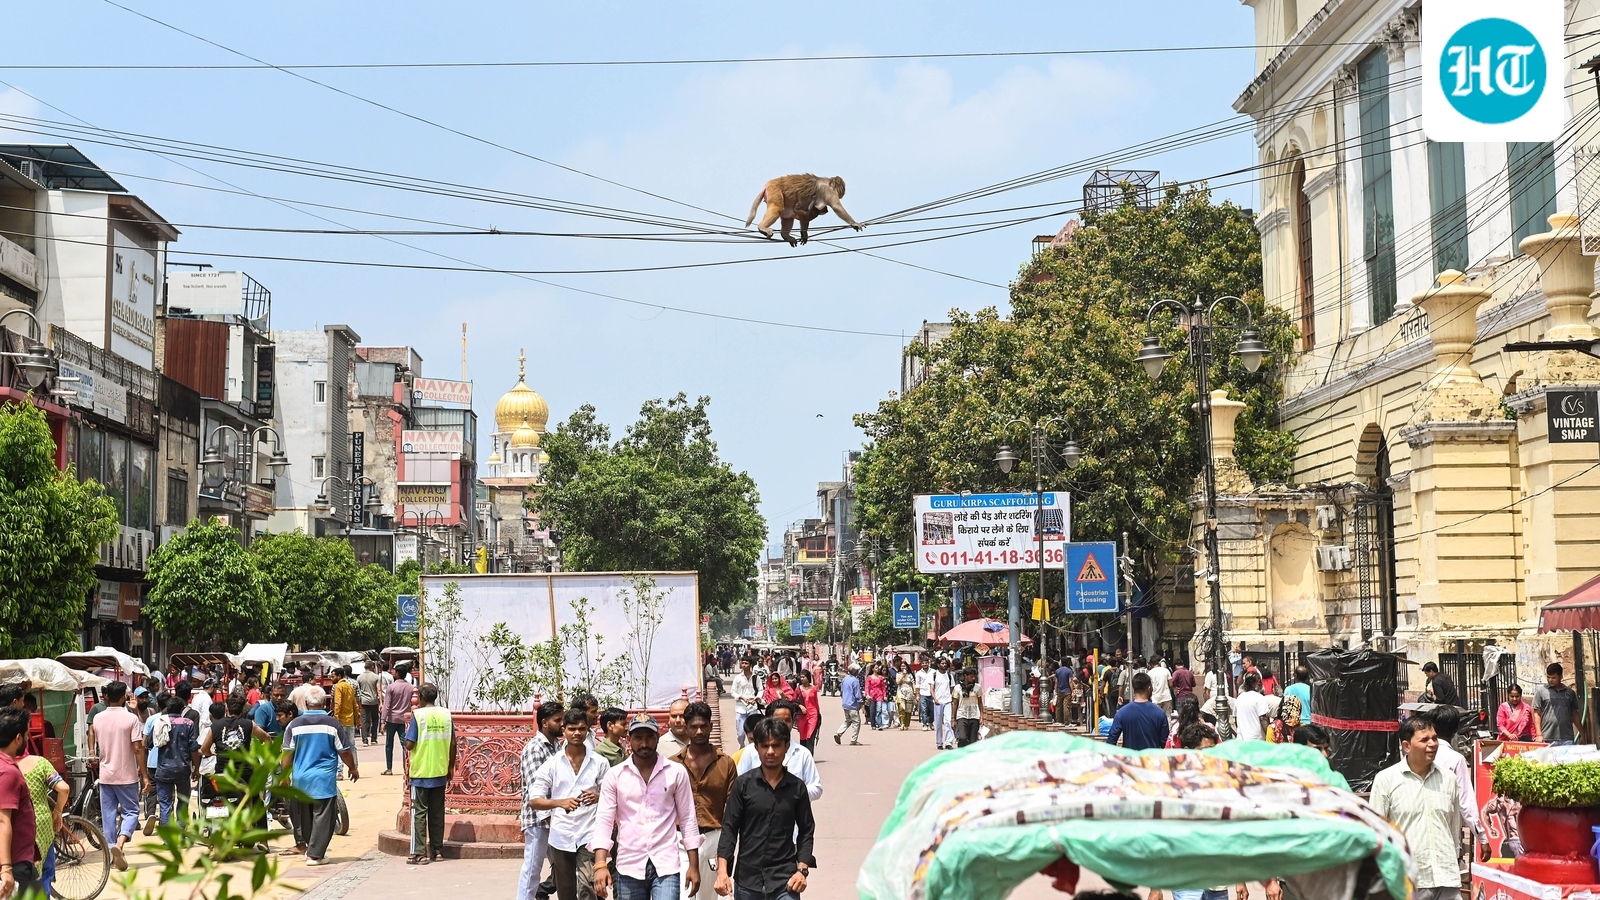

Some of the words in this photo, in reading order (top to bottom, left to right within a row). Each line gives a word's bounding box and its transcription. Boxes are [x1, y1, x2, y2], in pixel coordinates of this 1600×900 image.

[415, 380, 470, 394] NAVYA
[424, 392, 470, 402] COLLECTION
[1553, 417, 1595, 428] VINTAGE
[404, 432, 460, 442] NAVYA
[1561, 429, 1587, 440] SNAP
[354, 433, 362, 470] PUNEET
[414, 443, 461, 451] COLLECTION
[400, 486, 434, 494] NAVYA
[353, 472, 362, 523] FASHIONS
[933, 500, 958, 508] GURU
[961, 499, 987, 507] KIRPA
[953, 512, 968, 522] लोहे
[970, 511, 980, 521] की
[993, 510, 1007, 520] और
[957, 525, 979, 535] किराये
[991, 524, 1005, 535] लेने
[1006, 524, 1014, 534] के
[1015, 523, 1029, 534] लिए
[977, 537, 997, 548] संपर्क
[998, 537, 1011, 547] करें
[940, 549, 1064, 566] 011-41-18-3636
